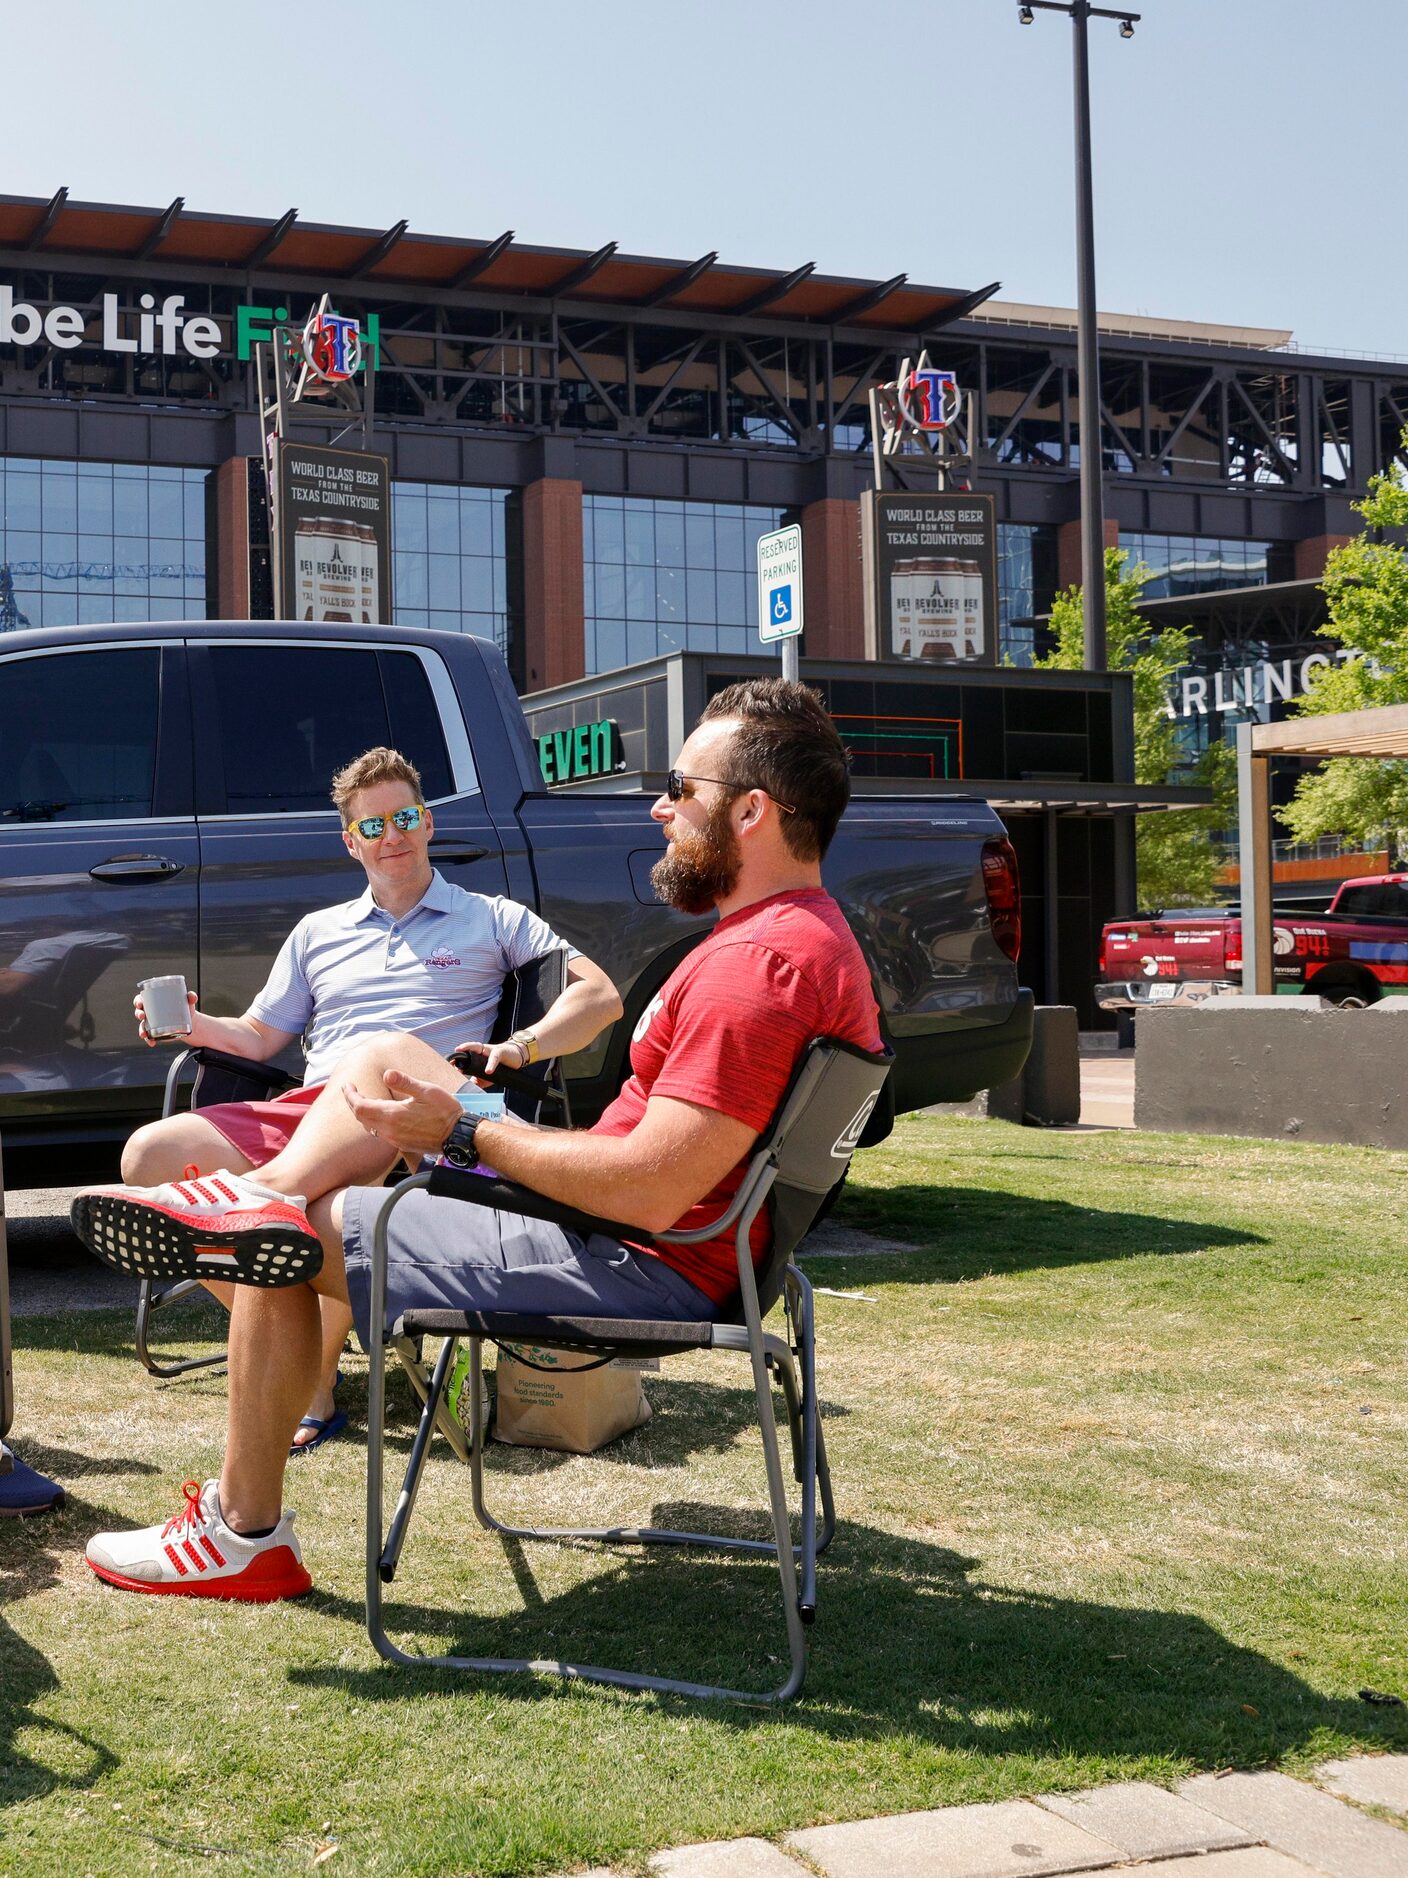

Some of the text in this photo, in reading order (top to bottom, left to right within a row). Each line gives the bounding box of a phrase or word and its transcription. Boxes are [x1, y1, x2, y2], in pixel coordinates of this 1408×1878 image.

[103, 292, 222, 359] Life
[291, 460, 379, 486] WORLD CLASS BEER
[318, 479, 353, 492] FROM THE
[291, 487, 380, 511] TEXAS COUNTRYSIDE
[886, 509, 984, 522] WORLD CLASS BEER
[916, 523, 938, 531] FROM
[886, 533, 985, 545] TEXAS COUNTRYSIDE
[761, 536, 798, 560] RESERVED
[317, 562, 357, 579] REVOLVER
[763, 560, 797, 582] PARKING
[915, 598, 959, 610] REVOLVER
[518, 1379, 555, 1391] Pioneering
[514, 1386, 564, 1399] food standards
